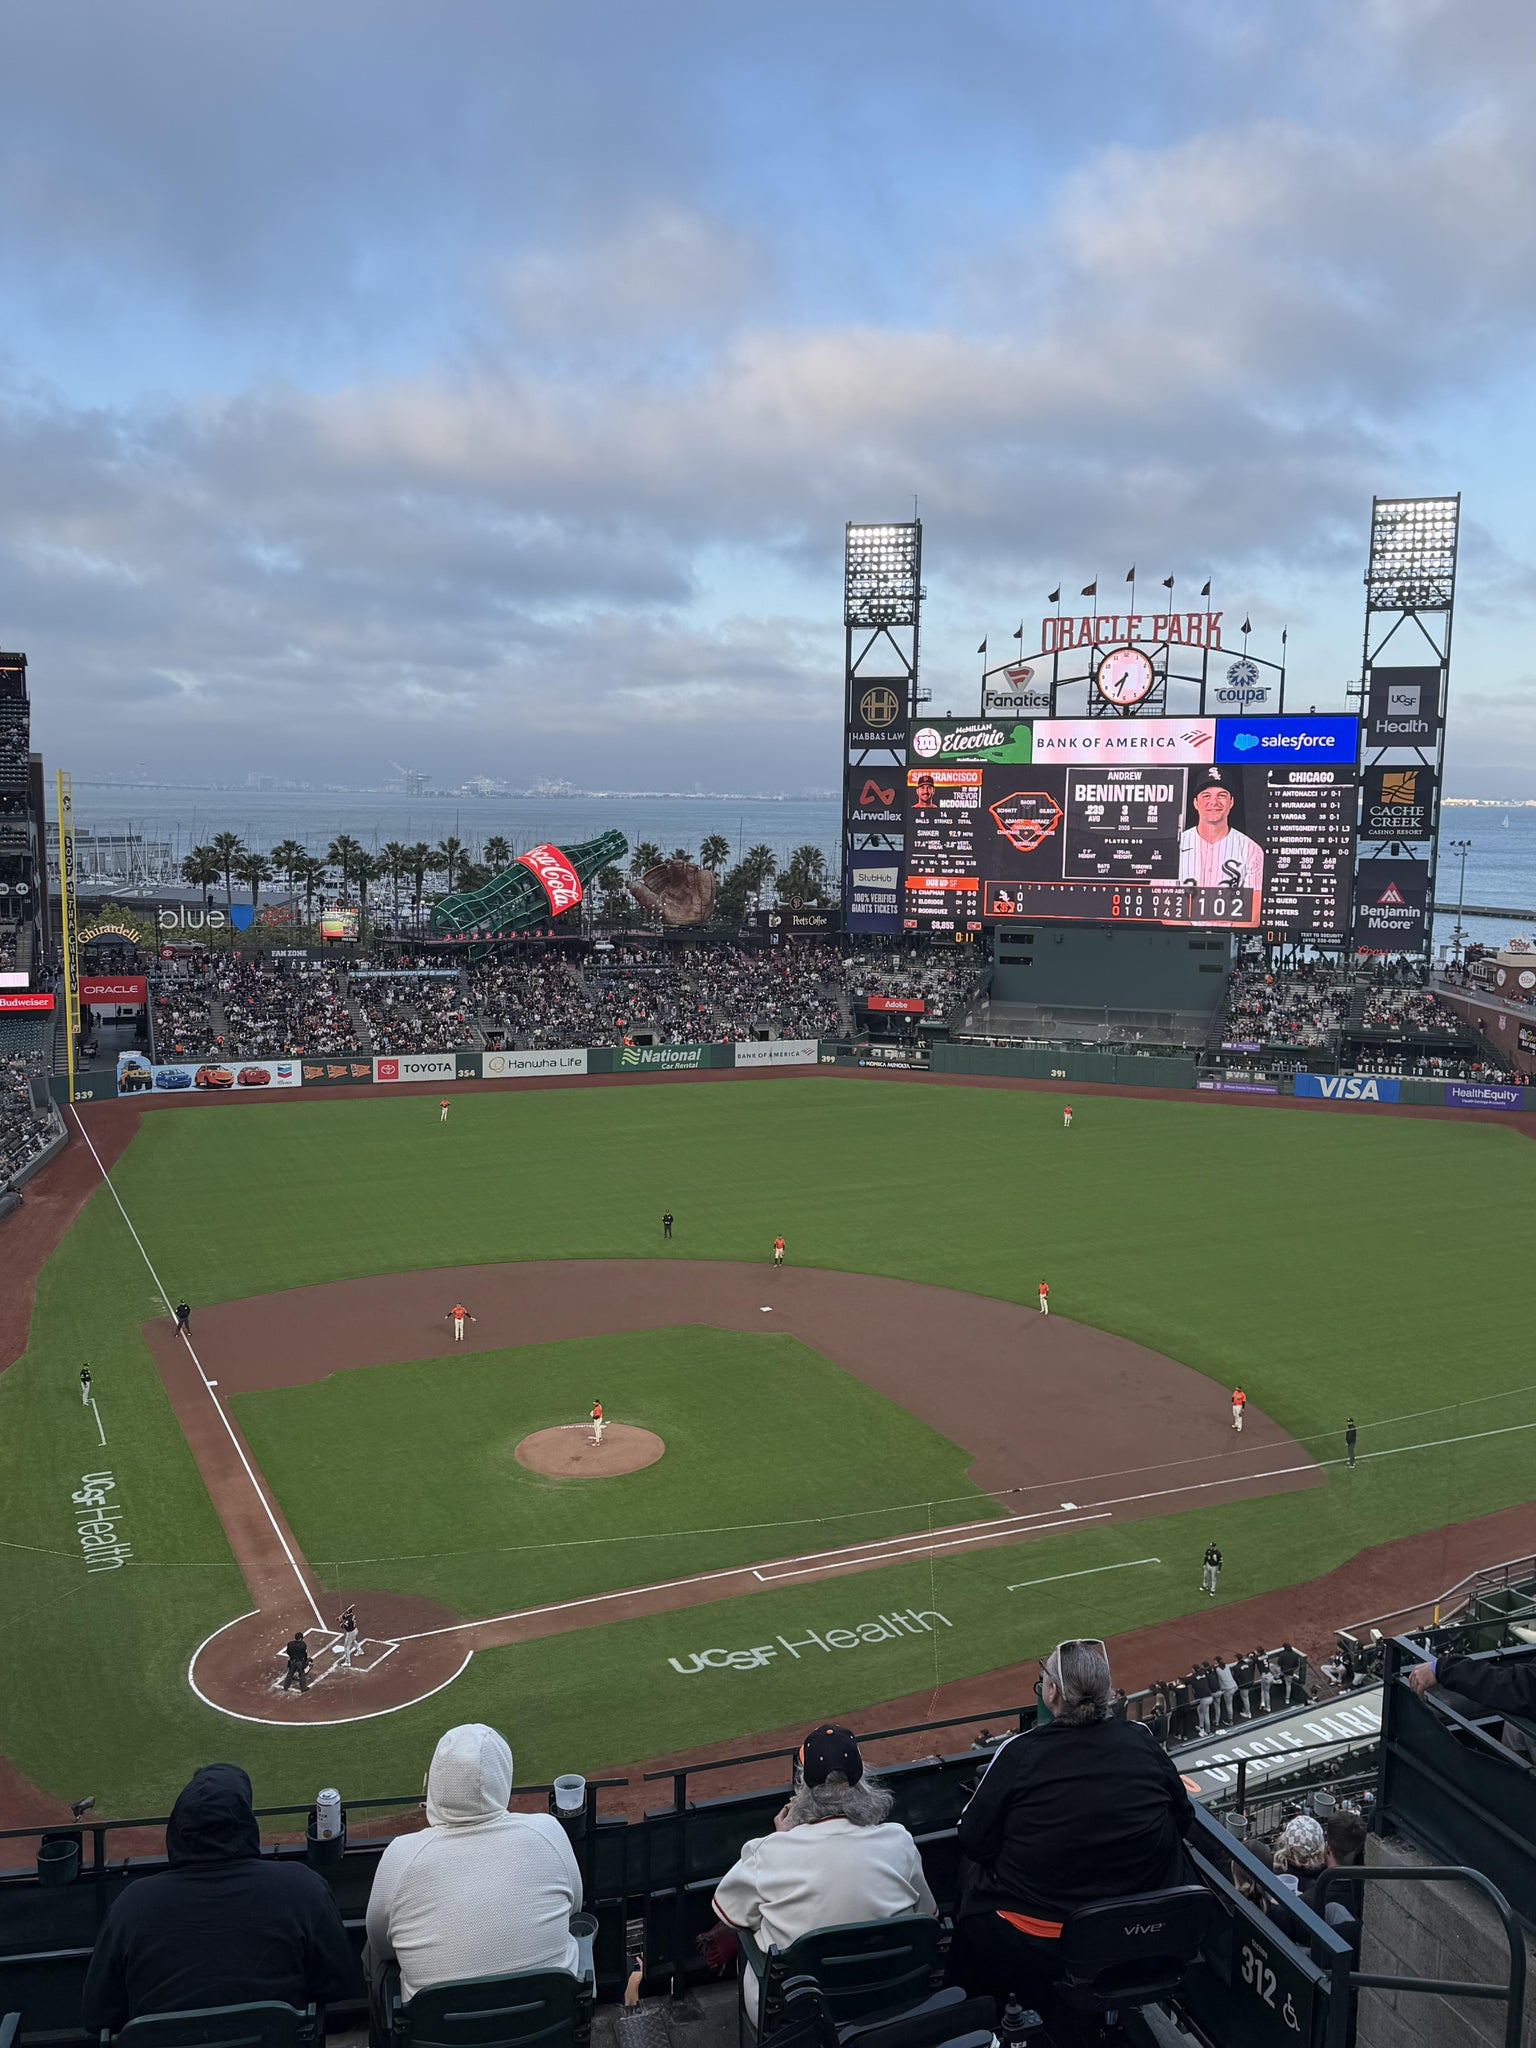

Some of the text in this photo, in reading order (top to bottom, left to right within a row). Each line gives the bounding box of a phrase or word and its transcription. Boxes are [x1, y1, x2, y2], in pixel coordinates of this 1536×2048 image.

[1042, 612, 1224, 654] ORACLE PARK
[985, 692, 1050, 707] Fanatics
[1219, 688, 1265, 705] coupa
[1391, 695, 1417, 706] UCSF
[956, 724, 992, 734] McMILLAN
[1376, 720, 1428, 733] Health
[942, 730, 1005, 752] Electric
[1037, 737, 1176, 748] BANK OF AMERICA
[1262, 733, 1335, 750] salesforce
[931, 773, 978, 782] FRANCISCO
[1108, 772, 1142, 780] ANDREW
[1289, 772, 1334, 783] CHICAGO
[1075, 785, 1174, 802] BENINTENDI
[852, 810, 902, 821] Airwallex
[1085, 805, 1158, 815] .239 3 21
[1370, 806, 1425, 816] CACHE
[1371, 817, 1422, 827] CREEK
[64, 836, 72, 877] ROOT
[859, 874, 892, 882] StubHub
[854, 893, 896, 904] 100% VERIFIED
[1017, 892, 1182, 907] 0 0 0 0 0 4 2
[852, 904, 898, 914] GIANTS TICKETS
[1017, 903, 1182, 918] 0 0 1 0 1 4 2
[1199, 899, 1243, 917] 1 0 2
[1361, 905, 1420, 918] Benjamin
[160, 905, 226, 929] blue
[809, 915, 827, 927] Coffee
[1368, 918, 1411, 929] Moore
[77, 923, 142, 944] Ghirardelli
[1358, 945, 1388, 957] Coors
[69, 936, 77, 992] CHIKIN
[84, 985, 139, 995] ORACLE
[0, 998, 49, 1007] Budweiser
[885, 1001, 908, 1009] Adobe
[641, 1049, 702, 1062] National
[404, 1062, 452, 1074] TOYOTA
[509, 1058, 582, 1069] Hanwha Life
[887, 1061, 910, 1069] MINOLTA
[458, 1069, 476, 1078] 354
[1051, 1070, 1066, 1078] 391
[1358, 1064, 1449, 1077] WELCOME TO THE
[1314, 1076, 1380, 1101] VISA
[75, 1091, 93, 1100] 339
[1453, 1088, 1517, 1102] HealthEquity
[72, 1471, 116, 1506] UCSF
[75, 1505, 133, 1573] Health
[668, 1609, 953, 1675] UCSF Health
[1303, 1705, 1383, 1752] PARK
[1124, 1922, 1162, 1937] vive
[1242, 1945, 1276, 2009] 312
